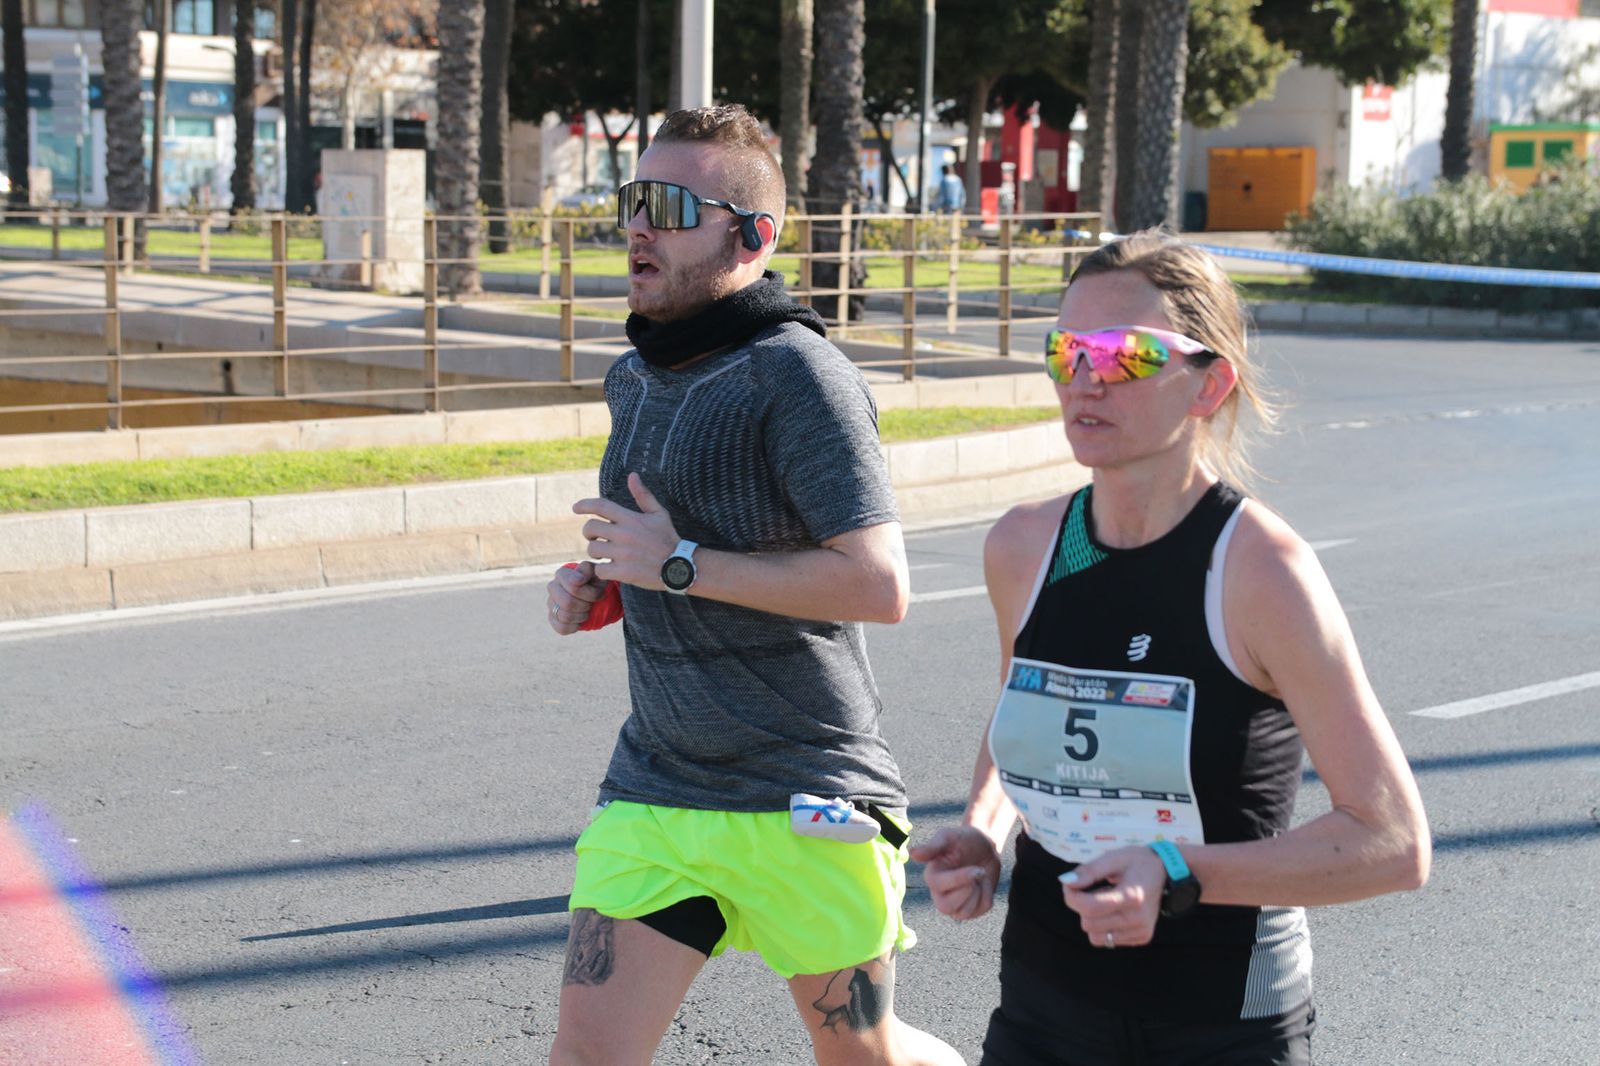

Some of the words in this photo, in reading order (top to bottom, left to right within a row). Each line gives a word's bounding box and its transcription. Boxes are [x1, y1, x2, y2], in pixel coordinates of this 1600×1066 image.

[1076, 686, 1107, 701] 2022
[1064, 707, 1100, 762] 5
[1056, 762, 1110, 781] KITIJA
